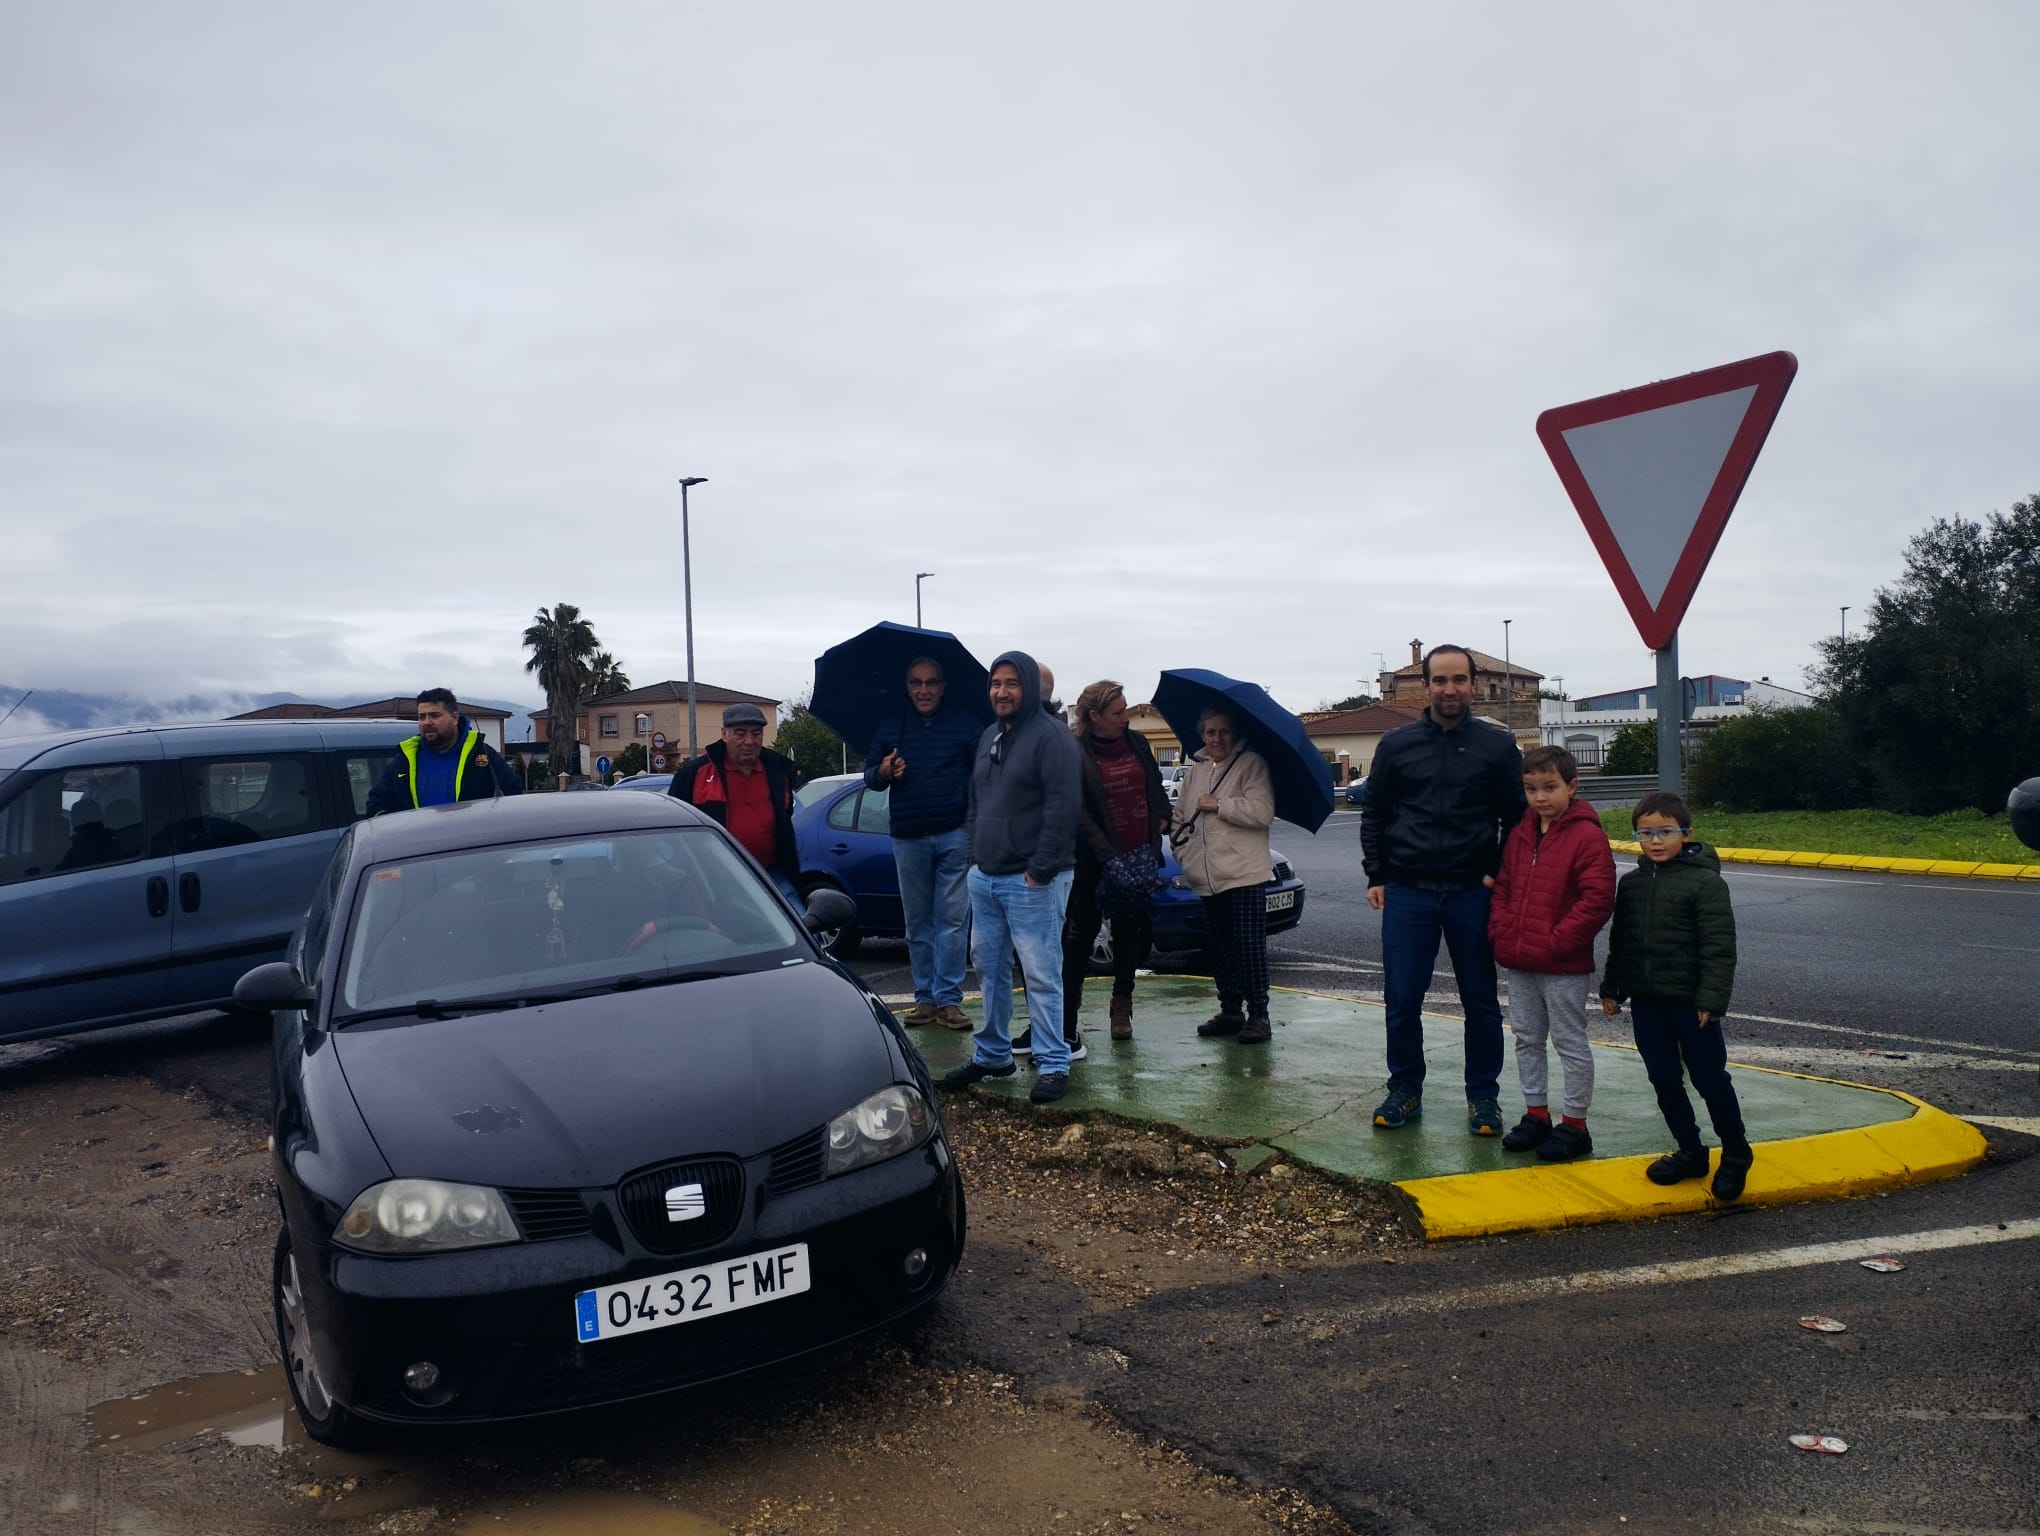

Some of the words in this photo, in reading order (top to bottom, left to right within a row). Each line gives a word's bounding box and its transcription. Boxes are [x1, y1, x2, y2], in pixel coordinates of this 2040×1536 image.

[1266, 895, 1281, 910] 802
[608, 1274, 713, 1327] 0432
[727, 1251, 797, 1303] FMF
[585, 1320, 593, 1332] E
